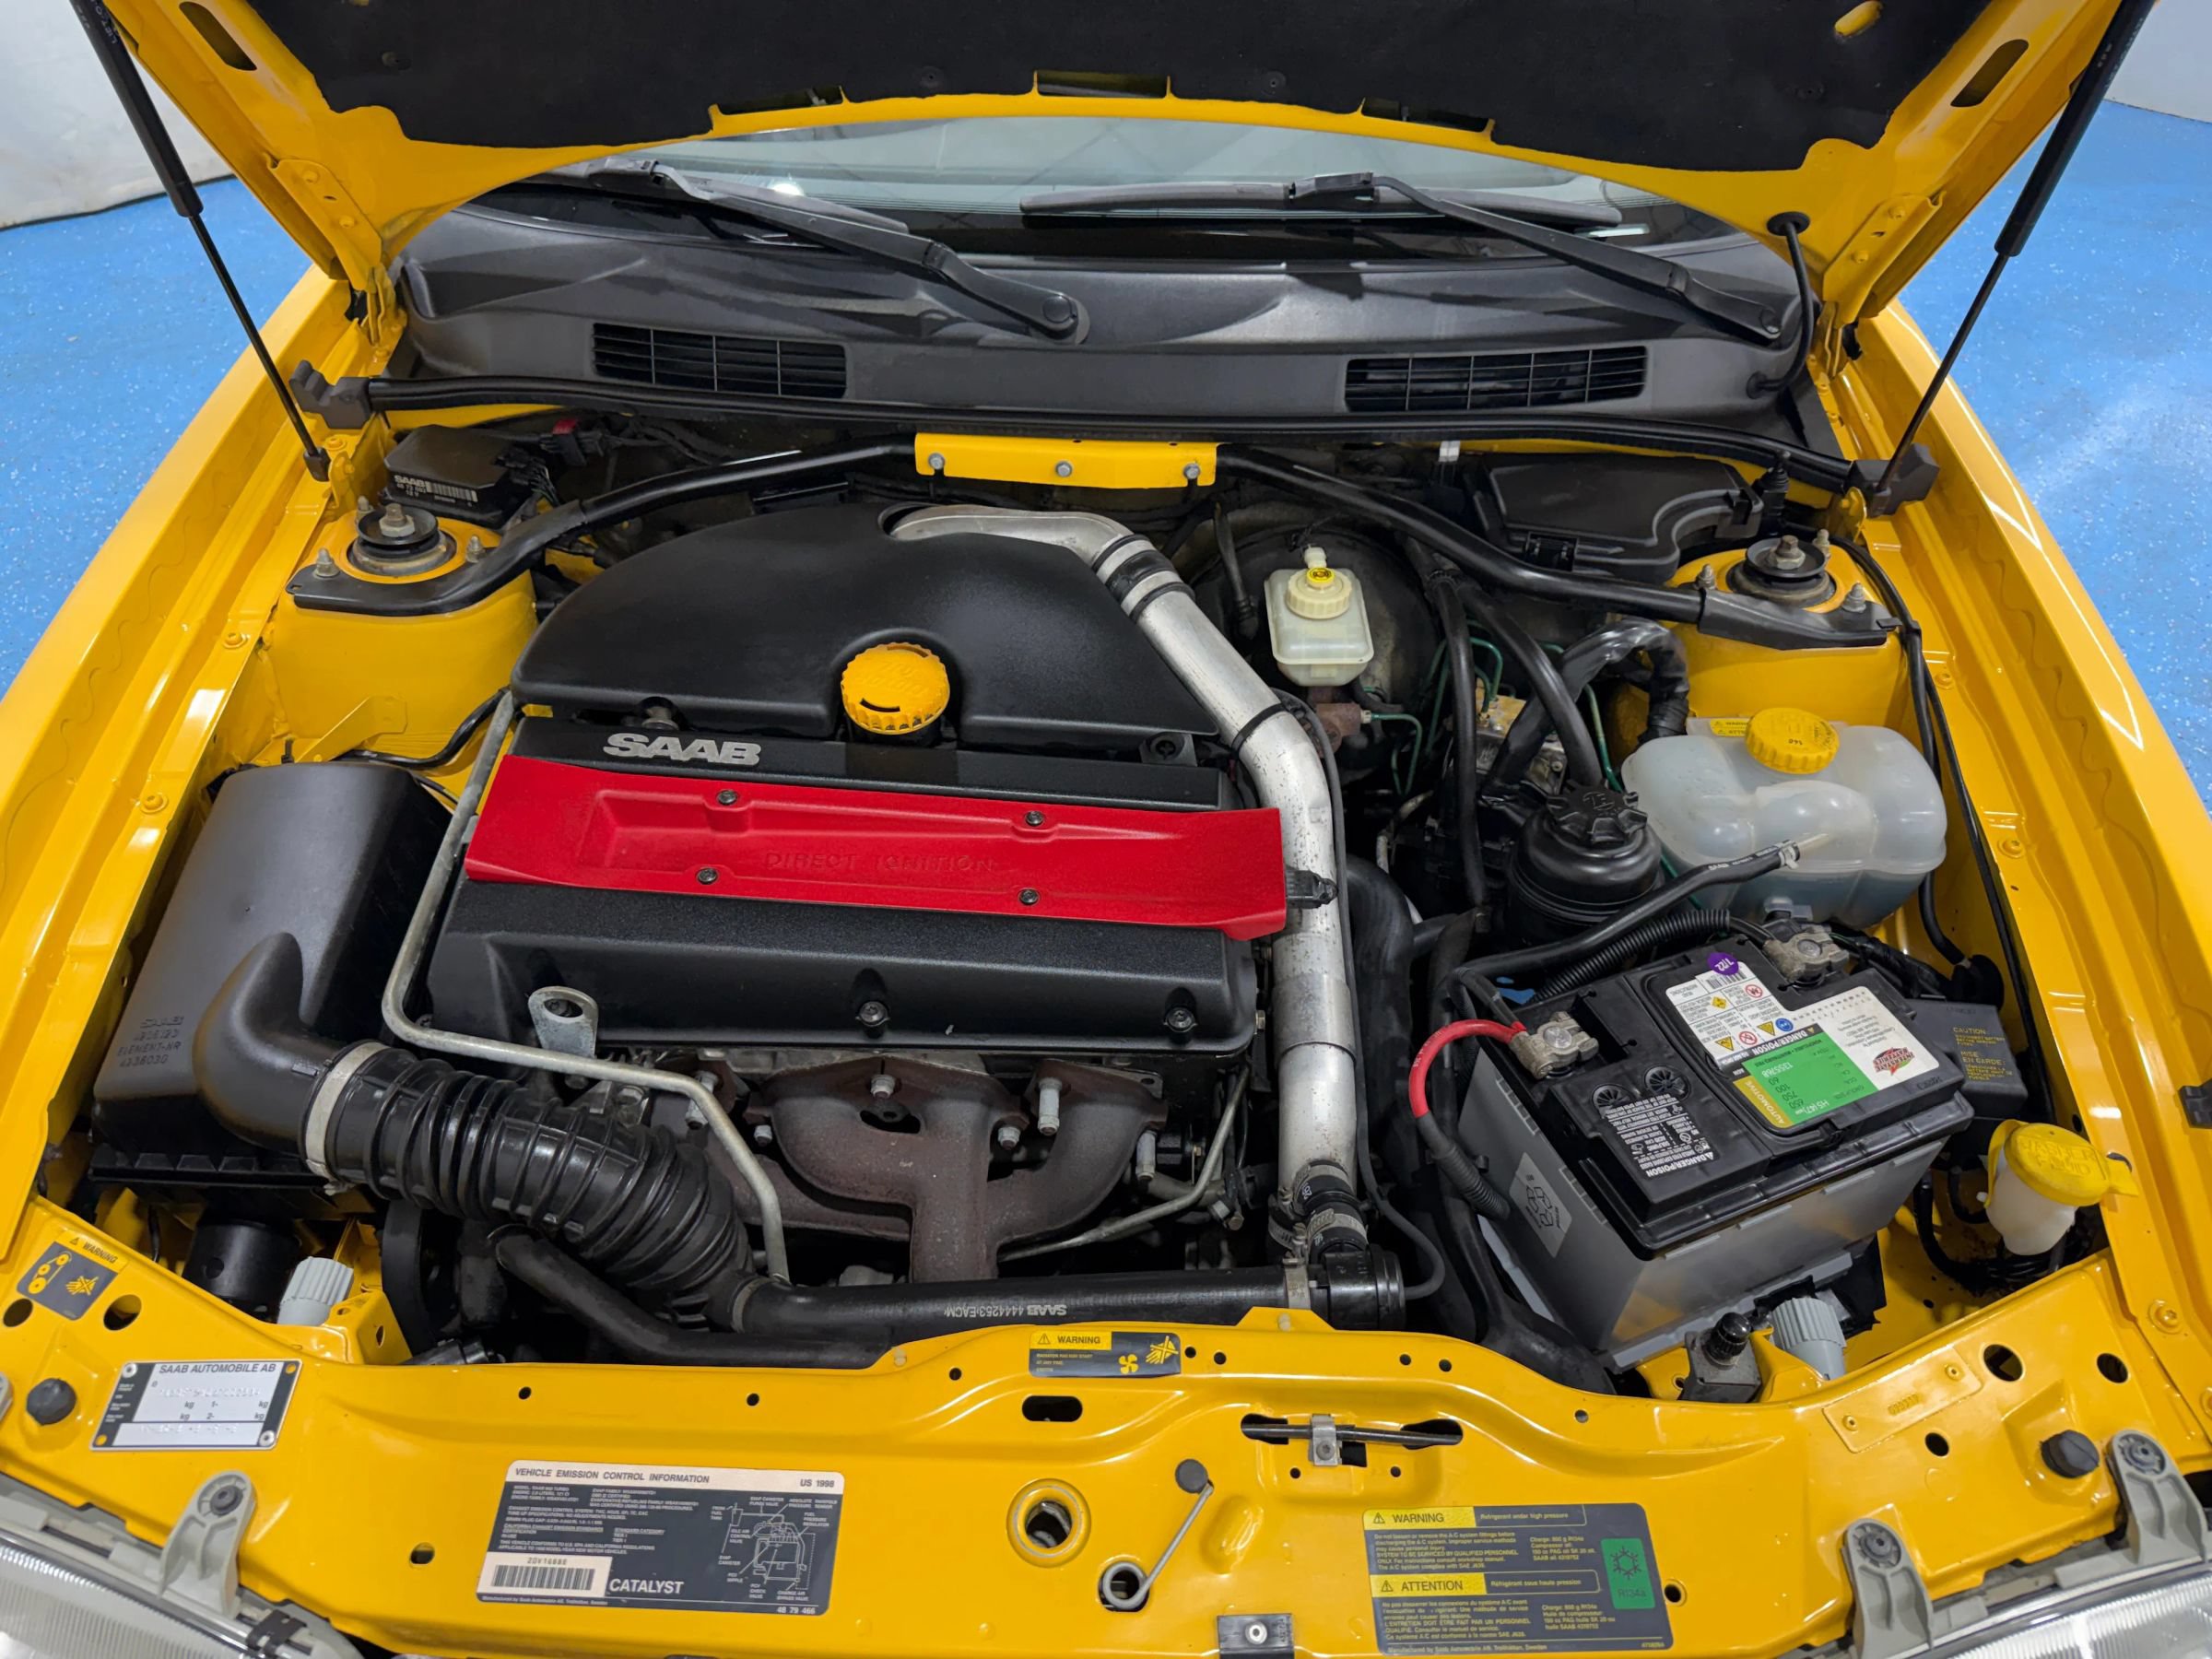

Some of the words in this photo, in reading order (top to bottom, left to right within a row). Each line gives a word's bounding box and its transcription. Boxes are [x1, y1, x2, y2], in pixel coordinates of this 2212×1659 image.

[394, 475, 426, 487] SAAB
[603, 733, 762, 765] SAAB
[765, 852, 859, 870] DIRECT
[874, 854, 996, 873] IGNITION
[1715, 958, 1735, 971] 7/22
[1752, 1030, 1808, 1055] DANGER/POISON
[1874, 1047, 1908, 1065] BATTERIES
[1875, 1052, 1914, 1073] INTERSTATE
[1775, 1083, 1791, 1095] 100
[1783, 1090, 1798, 1101] 750
[1745, 1080, 1785, 1124] AUTOMOTIVE
[1645, 1154, 1708, 1178] DANGER/POISON
[83, 1241, 118, 1264] WARNING
[1027, 1304, 1067, 1316] SAAB
[1057, 1335, 1100, 1344] WARNING
[159, 1364, 189, 1373] SAAB
[190, 1364, 259, 1373] AUTOMOBILE
[261, 1363, 276, 1372] AB
[184, 1401, 194, 1409] kg
[259, 1400, 269, 1408] kg
[180, 1413, 190, 1421] kg
[254, 1413, 265, 1421] kg
[515, 1468, 552, 1477] VEHICLE
[556, 1470, 599, 1479] EMISSION
[603, 1471, 645, 1481] CONTROL
[649, 1473, 710, 1484] INFORMATION
[800, 1478, 814, 1488] US
[816, 1479, 835, 1488] 1998
[1393, 1513, 1444, 1524] WARNING
[609, 1579, 685, 1594] CATALYST
[1401, 1581, 1463, 1592] ATTENTION
[1618, 1588, 1647, 1599] R134a
